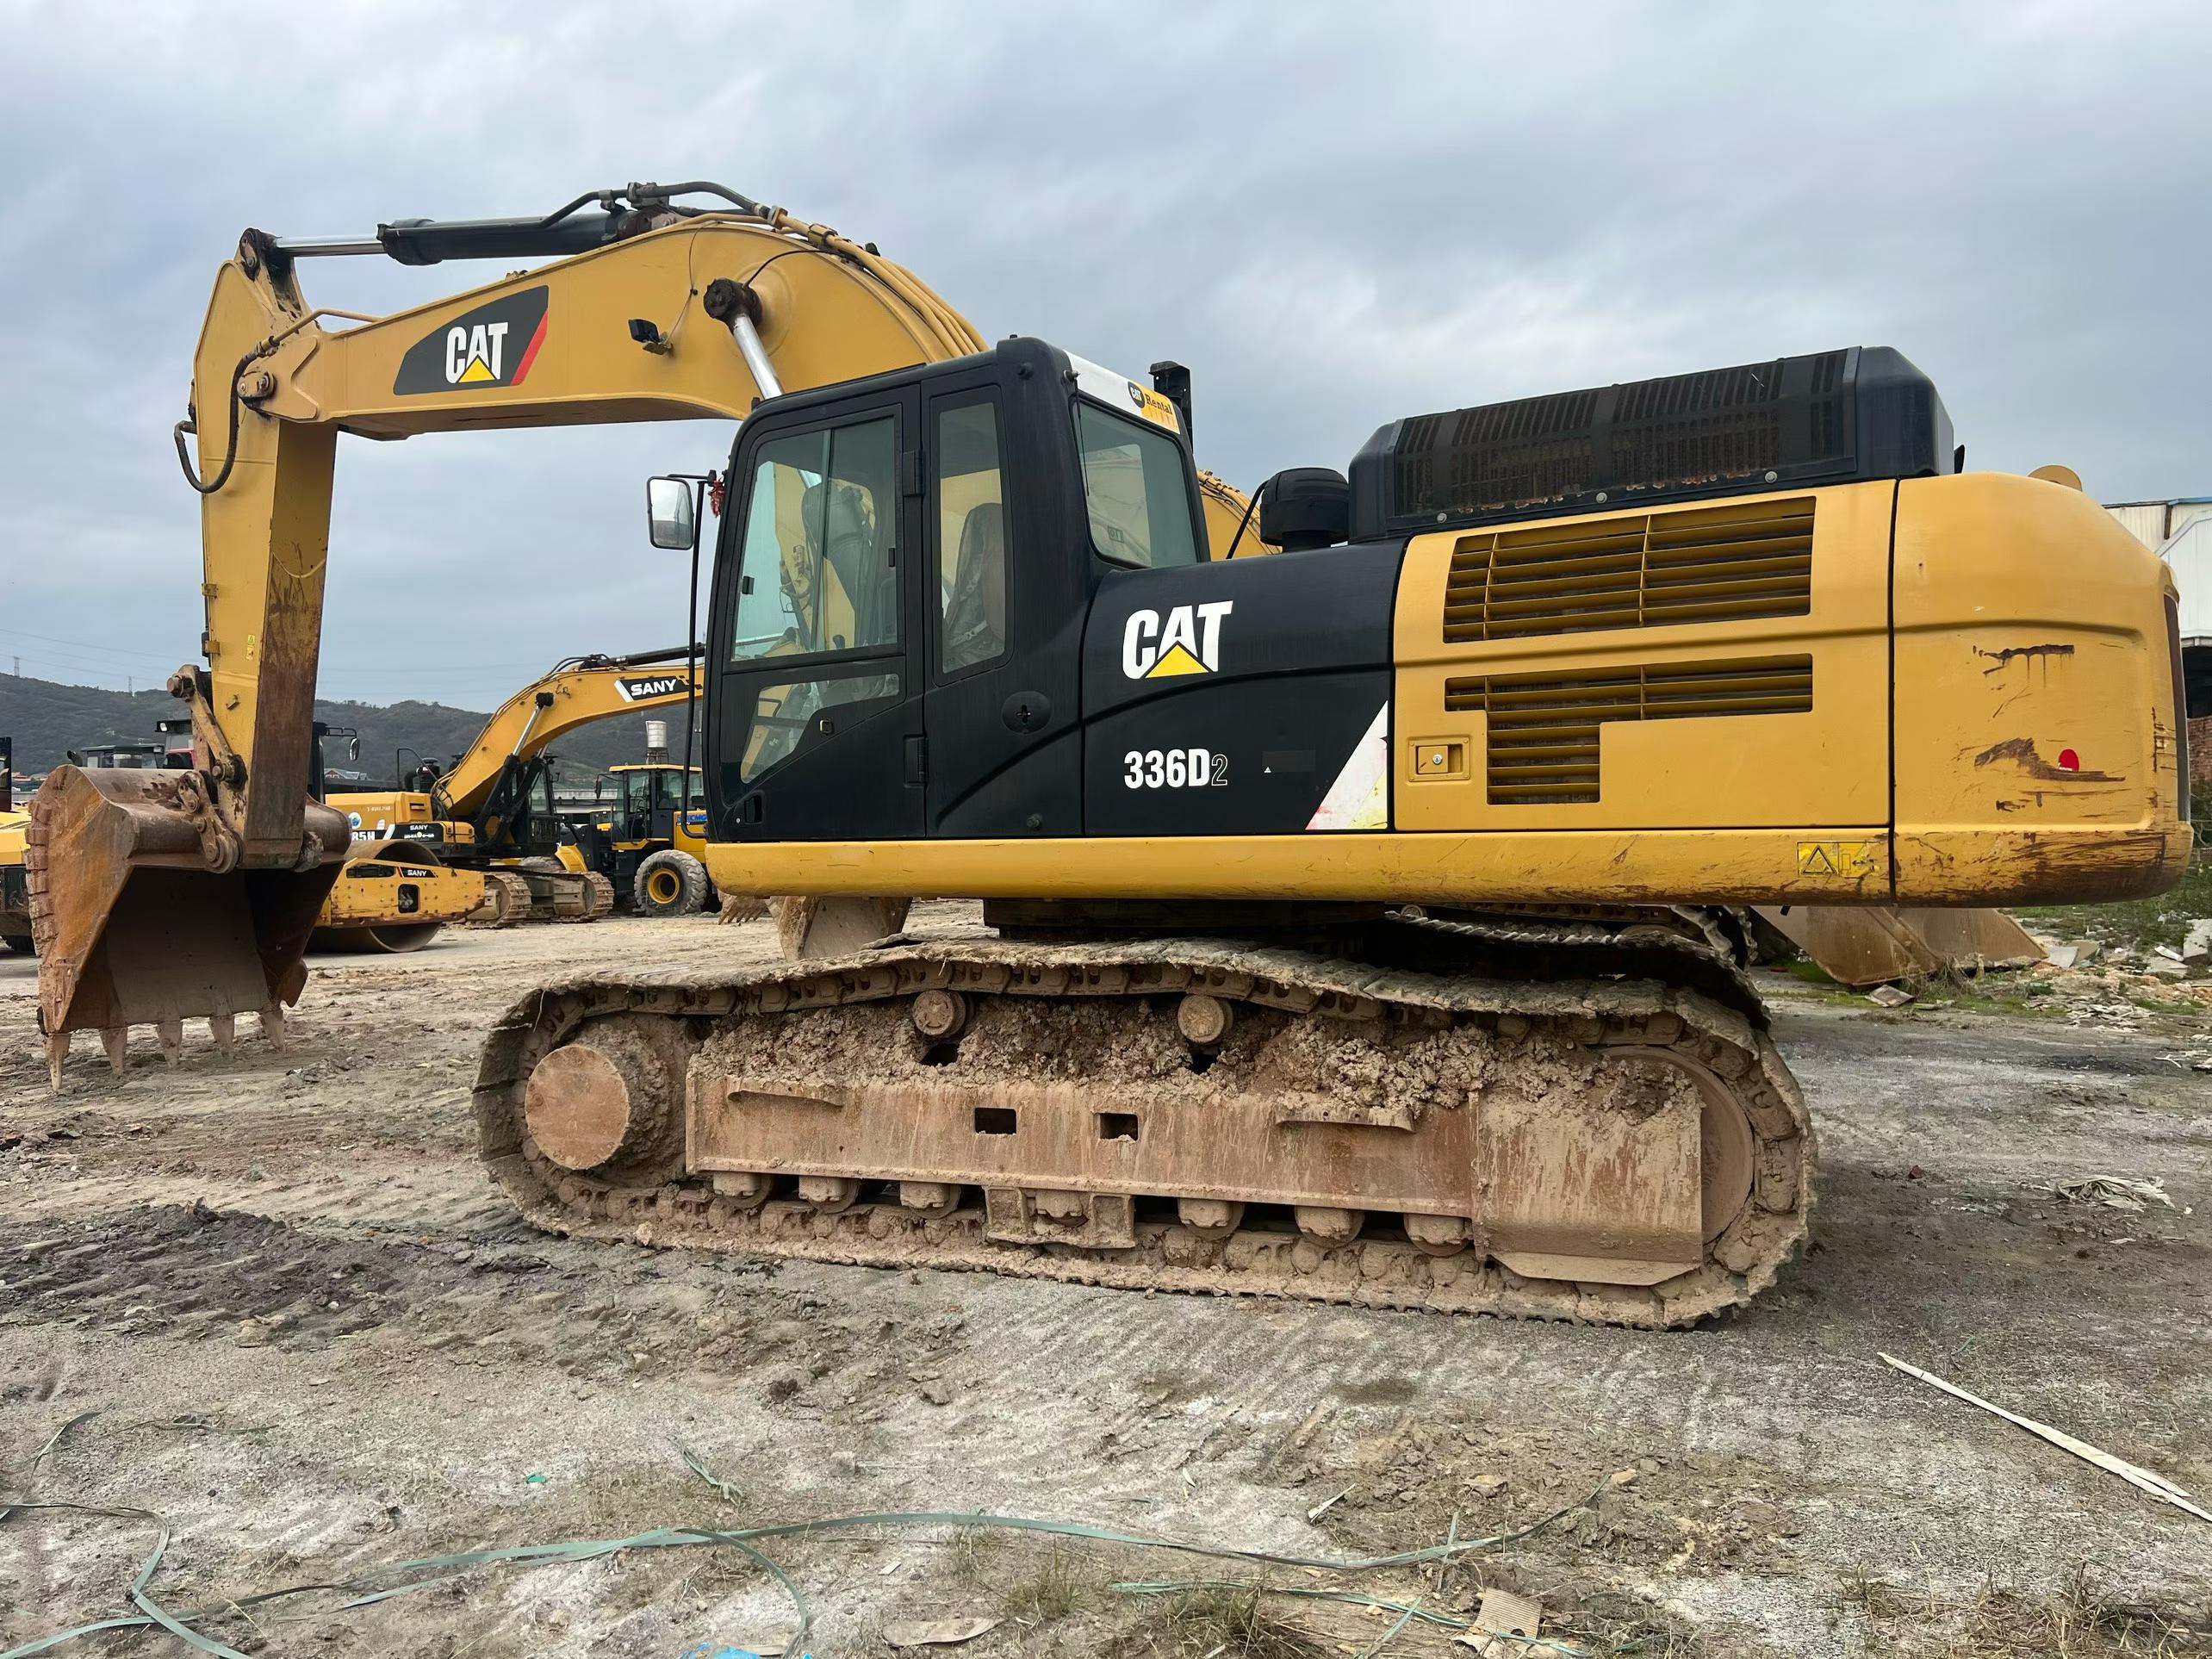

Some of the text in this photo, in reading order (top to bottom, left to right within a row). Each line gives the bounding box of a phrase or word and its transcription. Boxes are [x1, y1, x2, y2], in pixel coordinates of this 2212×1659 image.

[445, 322, 509, 384] CAT
[1129, 386, 1173, 415] CAT Rental
[1122, 600, 1233, 680] CAT
[631, 679, 677, 697] SANY
[1123, 748, 1228, 790] 336D2
